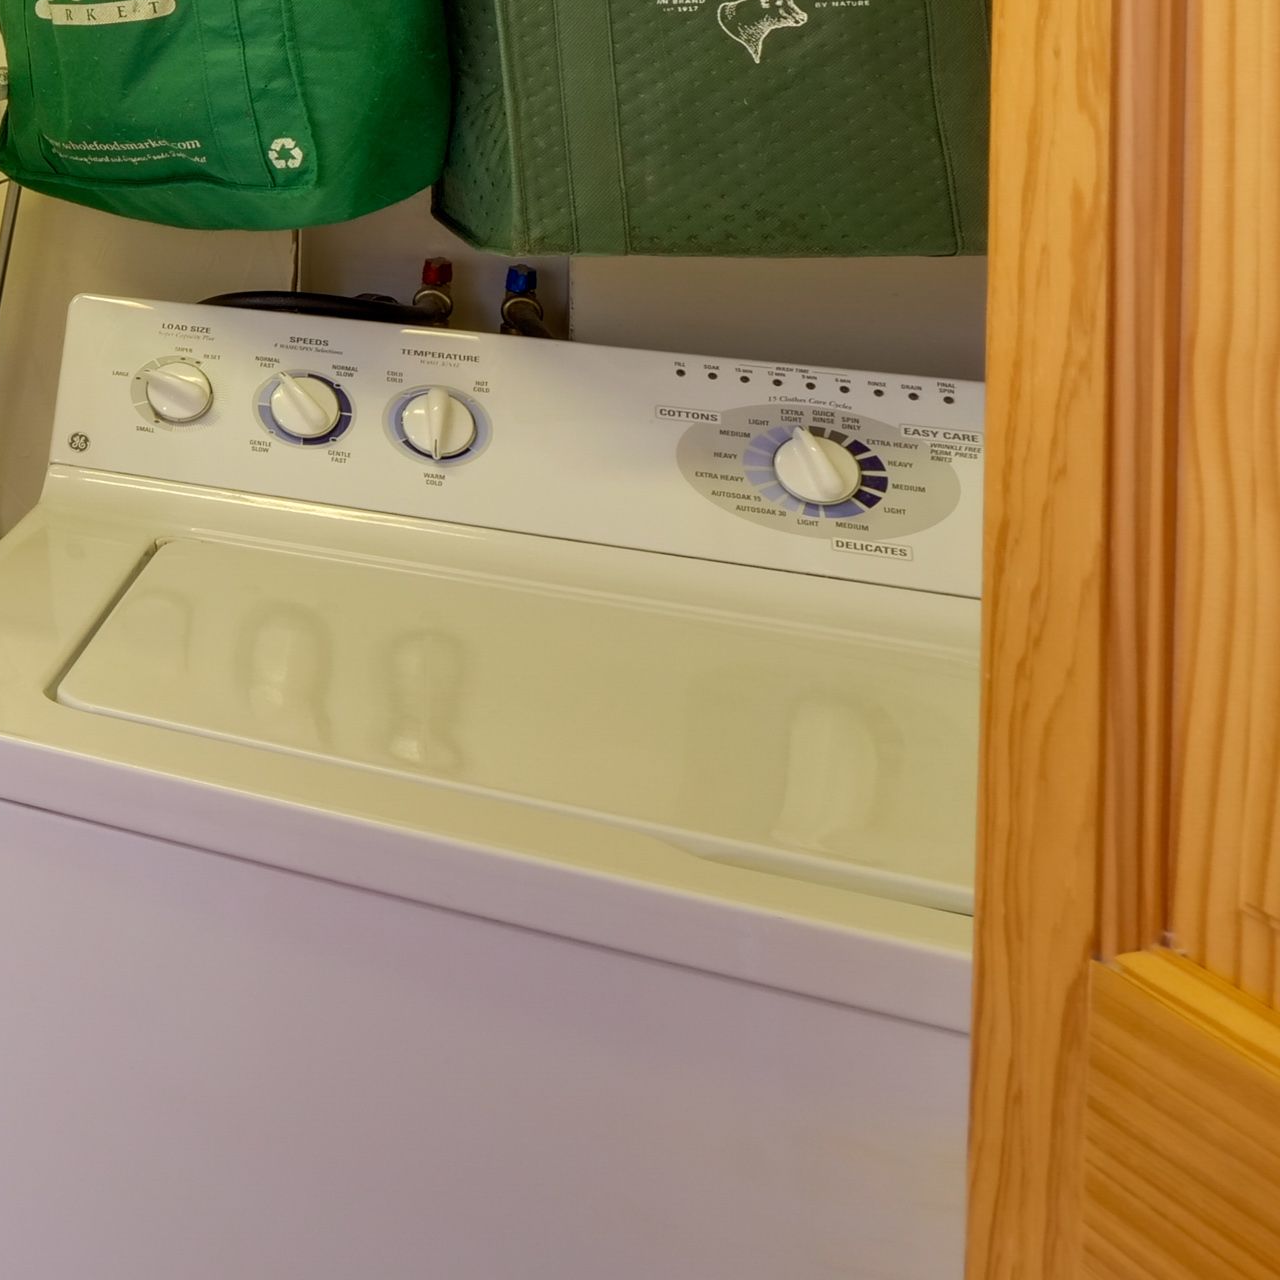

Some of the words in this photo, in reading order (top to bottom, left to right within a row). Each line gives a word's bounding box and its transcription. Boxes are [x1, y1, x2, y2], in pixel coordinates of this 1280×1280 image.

[814, 0, 830, 9] BY
[831, 0, 870, 8] NATURE
[161, 322, 188, 331] LOAD
[190, 325, 212, 334] SIZE
[289, 336, 330, 347] SPEEDS
[255, 355, 281, 364] NORMAL
[400, 348, 480, 363] TEMPERATURE
[331, 364, 359, 373] NORMAL
[386, 370, 404, 378] COLD
[386, 376, 404, 384] COLD
[901, 384, 923, 392] DRAIN
[937, 381, 956, 389] FINAL
[472, 386, 490, 394] COLD
[828, 400, 853, 410] Cycles
[659, 408, 719, 422] COTTONS
[780, 408, 805, 416] EXTRA
[812, 409, 836, 417] QUICK
[748, 418, 770, 426] LIGHT
[780, 415, 803, 423] LIGHT
[812, 416, 835, 424] RINSE
[841, 416, 860, 424] SPIN
[135, 425, 155, 433] SMALL
[841, 423, 861, 431] ONLY
[719, 429, 751, 438] MEDIUM
[903, 427, 939, 438] EASY
[943, 431, 980, 443] CARE
[249, 439, 272, 448] GENTLE
[866, 438, 891, 447] EXTRA
[893, 442, 919, 450] HEAVY
[930, 442, 962, 452] WRINKLE
[251, 446, 270, 454] SLOW
[327, 449, 351, 458] GENTLE
[713, 451, 738, 460] HEAVY
[930, 455, 953, 463] KNITS
[954, 451, 978, 459] PRESS
[330, 456, 347, 464] FAST
[887, 460, 913, 468] HEAVY
[423, 472, 446, 481] WARM
[695, 470, 719, 479] EXTRA
[720, 473, 745, 483] HEAVY
[425, 479, 443, 487] COLD
[891, 483, 926, 493] MEDIUM
[711, 489, 752, 501] AUTOSOAK
[735, 504, 777, 516] AUTOSOAK
[883, 506, 906, 515] LIGHT
[797, 518, 820, 527] LIGHT
[835, 521, 870, 531] MEDIUM
[835, 539, 908, 557] DELICATES
